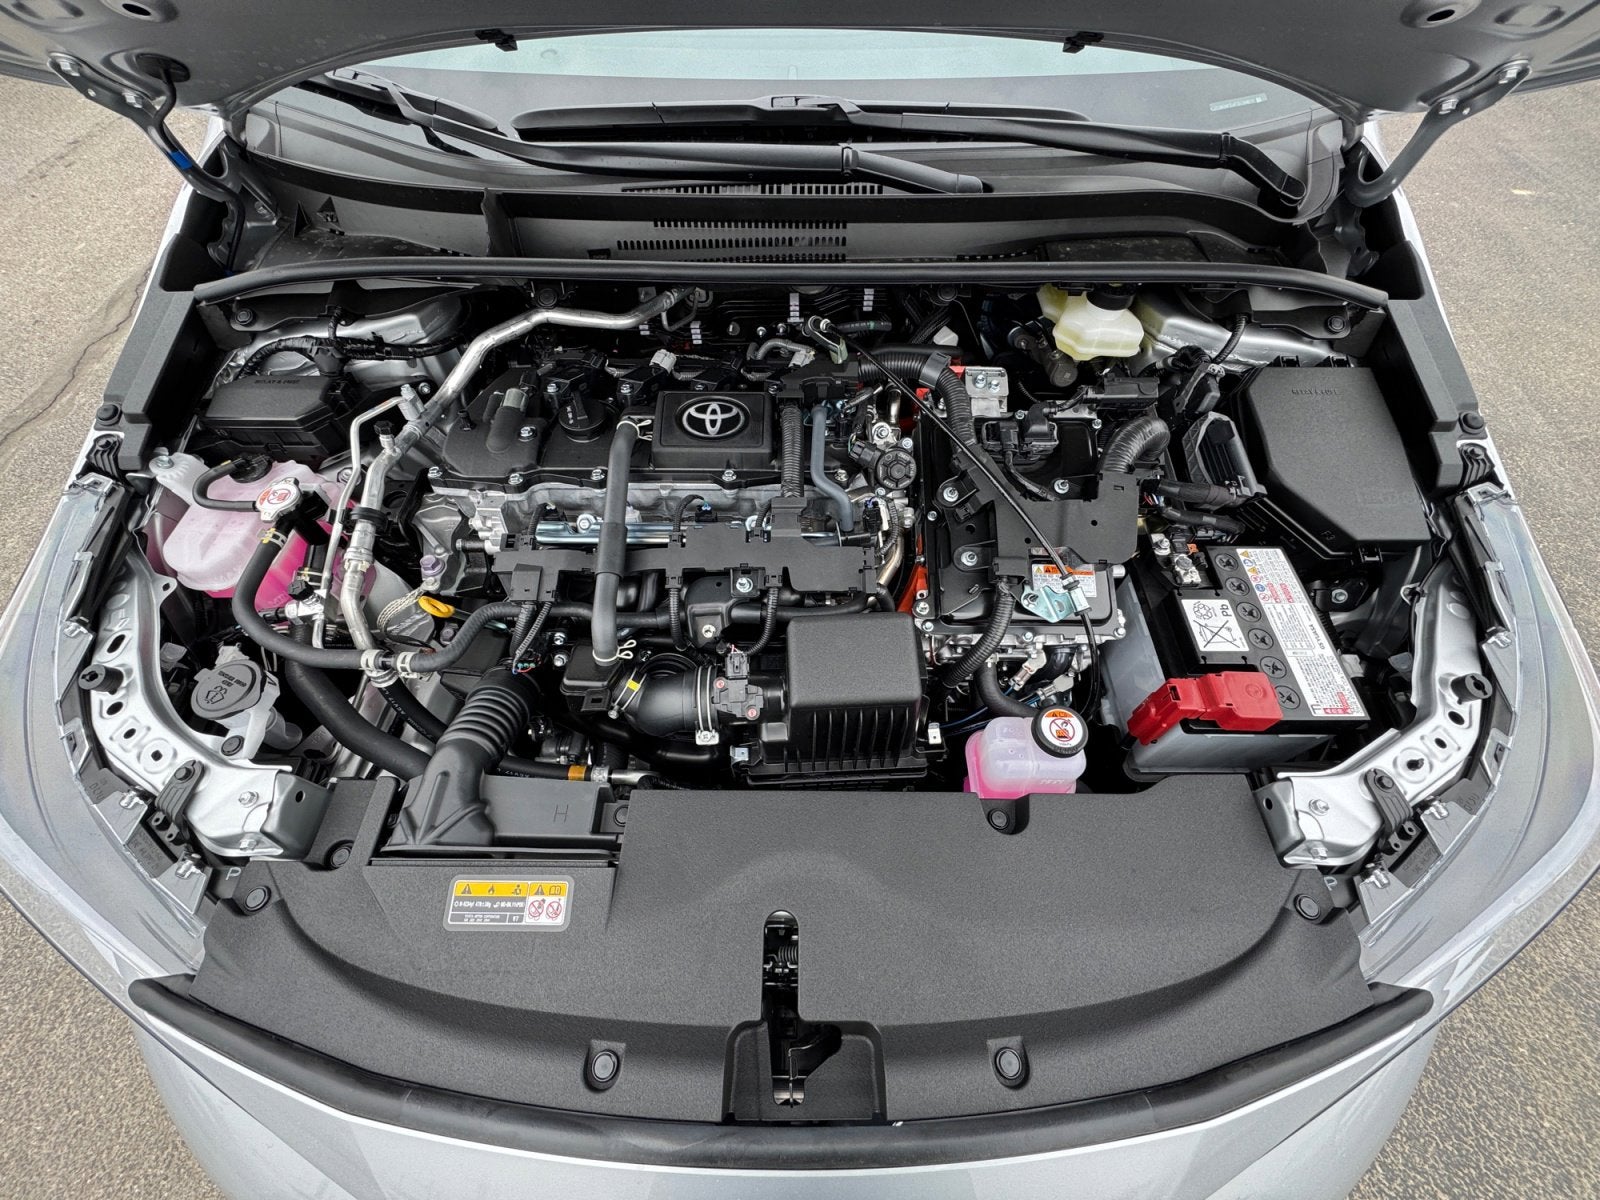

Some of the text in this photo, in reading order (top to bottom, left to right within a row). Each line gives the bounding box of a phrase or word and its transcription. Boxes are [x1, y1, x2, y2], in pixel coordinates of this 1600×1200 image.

[1218, 603, 1232, 618] Pb
[553, 804, 569, 823] H
[225, 866, 242, 881] P
[1323, 876, 1338, 891] P
